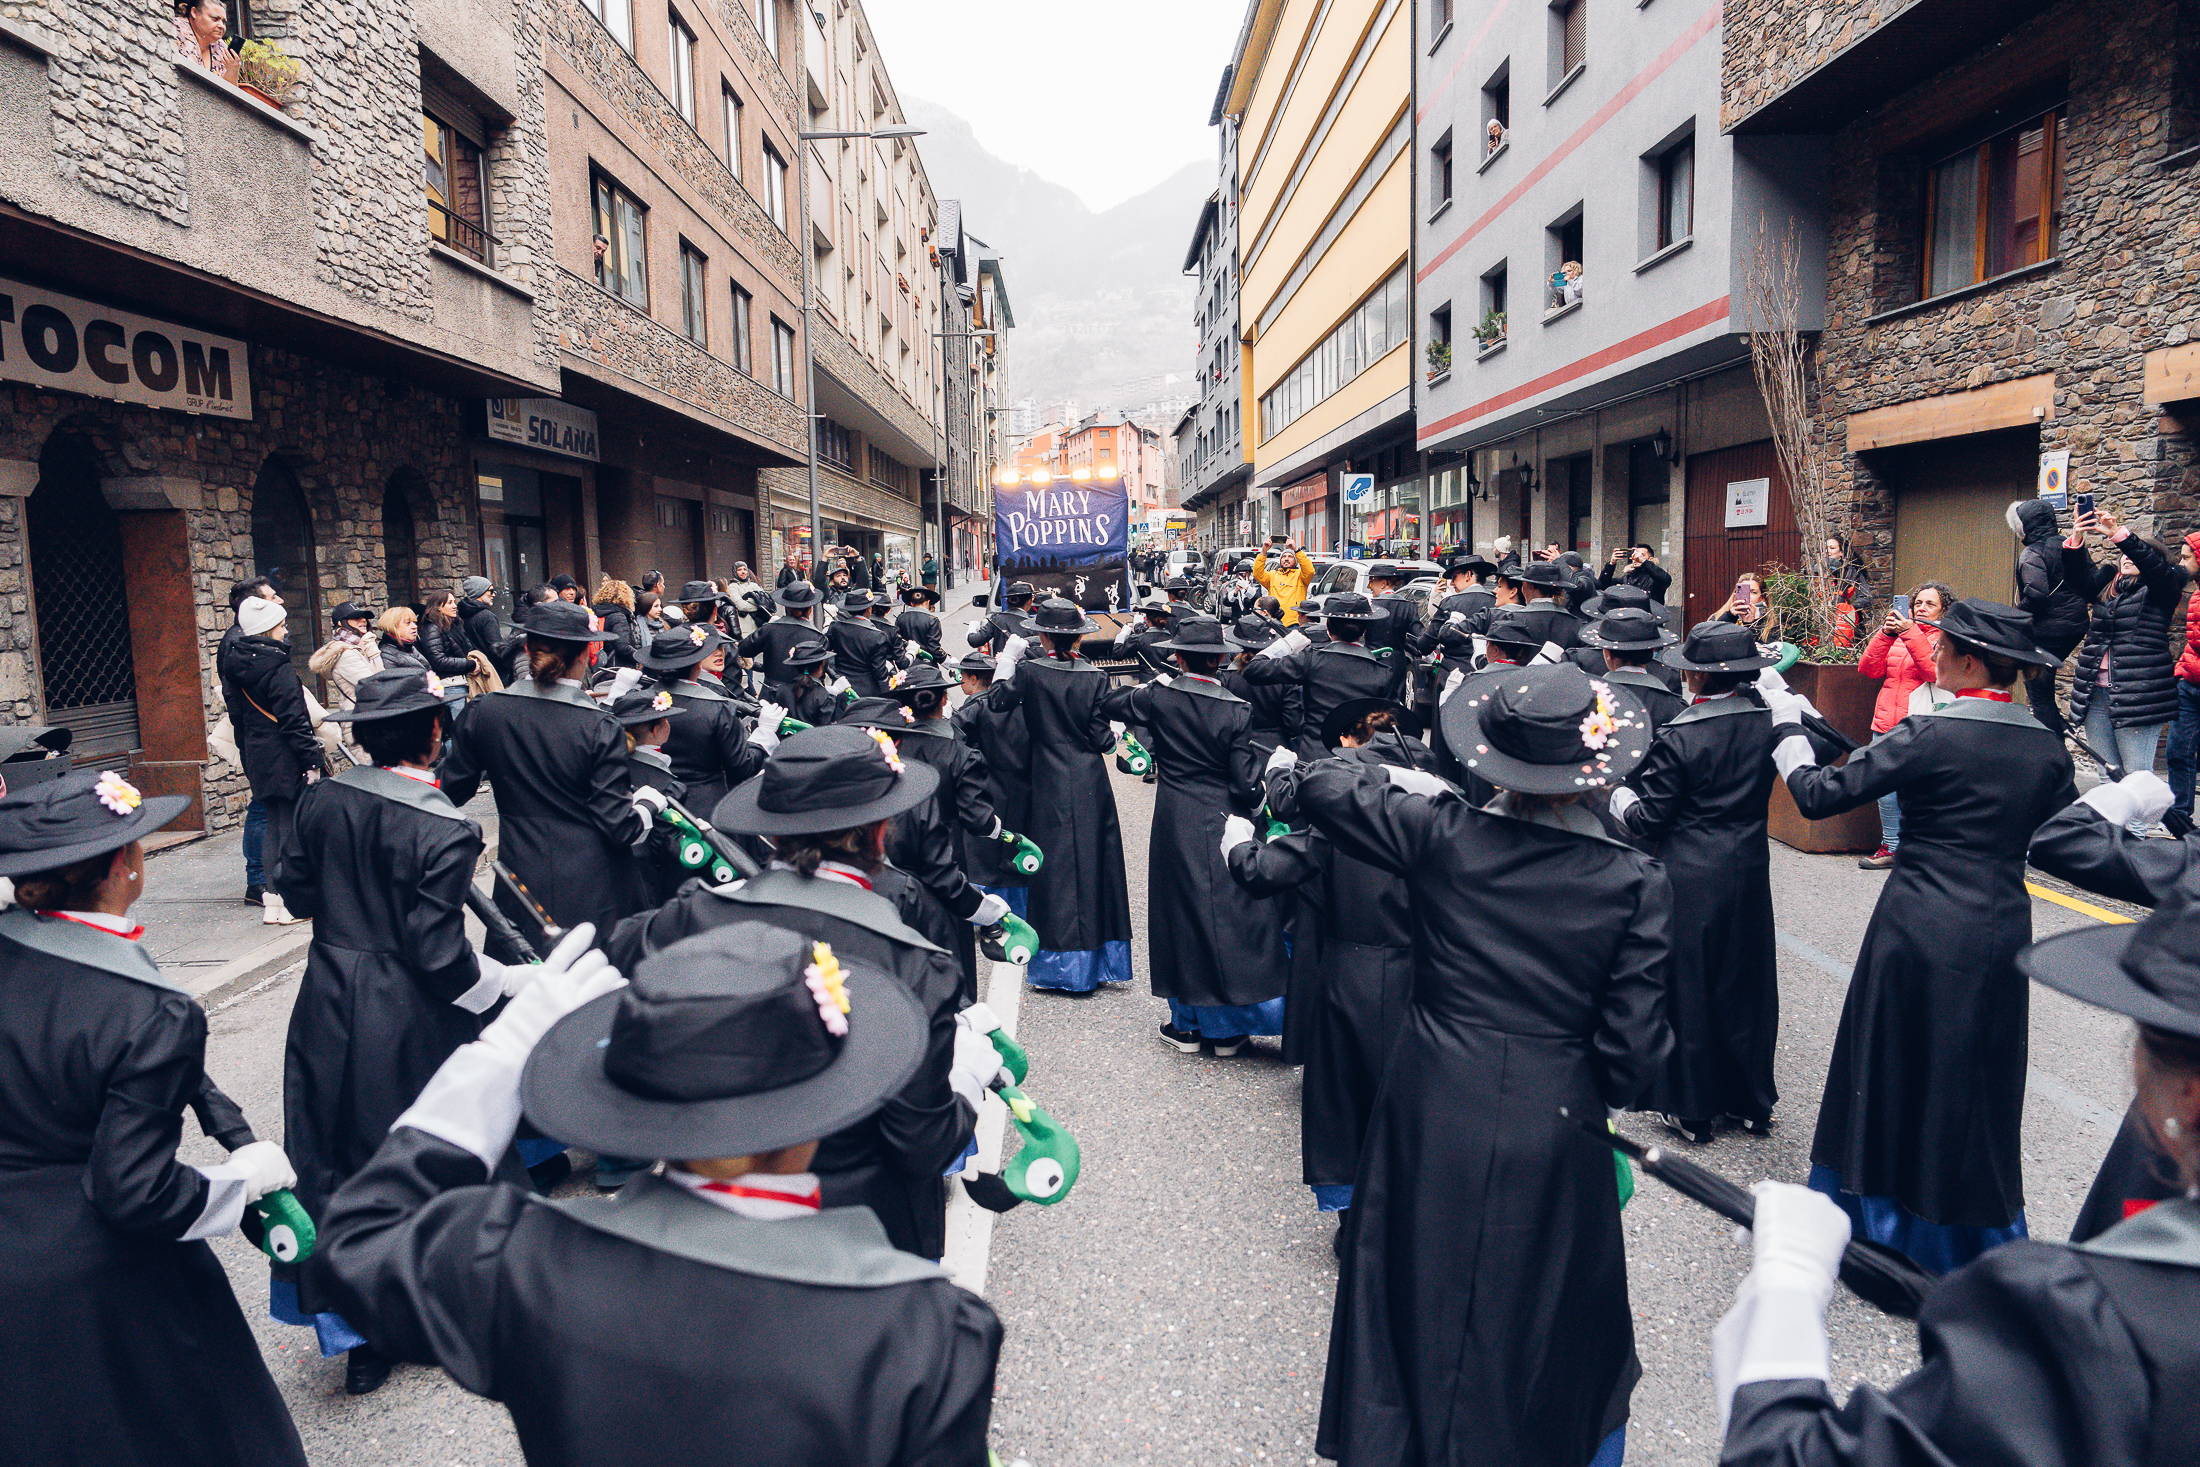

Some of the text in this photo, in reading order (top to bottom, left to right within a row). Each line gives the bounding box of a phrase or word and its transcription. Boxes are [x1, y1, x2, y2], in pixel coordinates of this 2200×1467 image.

[528, 415, 597, 456] SOLANA
[1024, 489, 1091, 522] MARY
[1007, 511, 1110, 552] POPPINS
